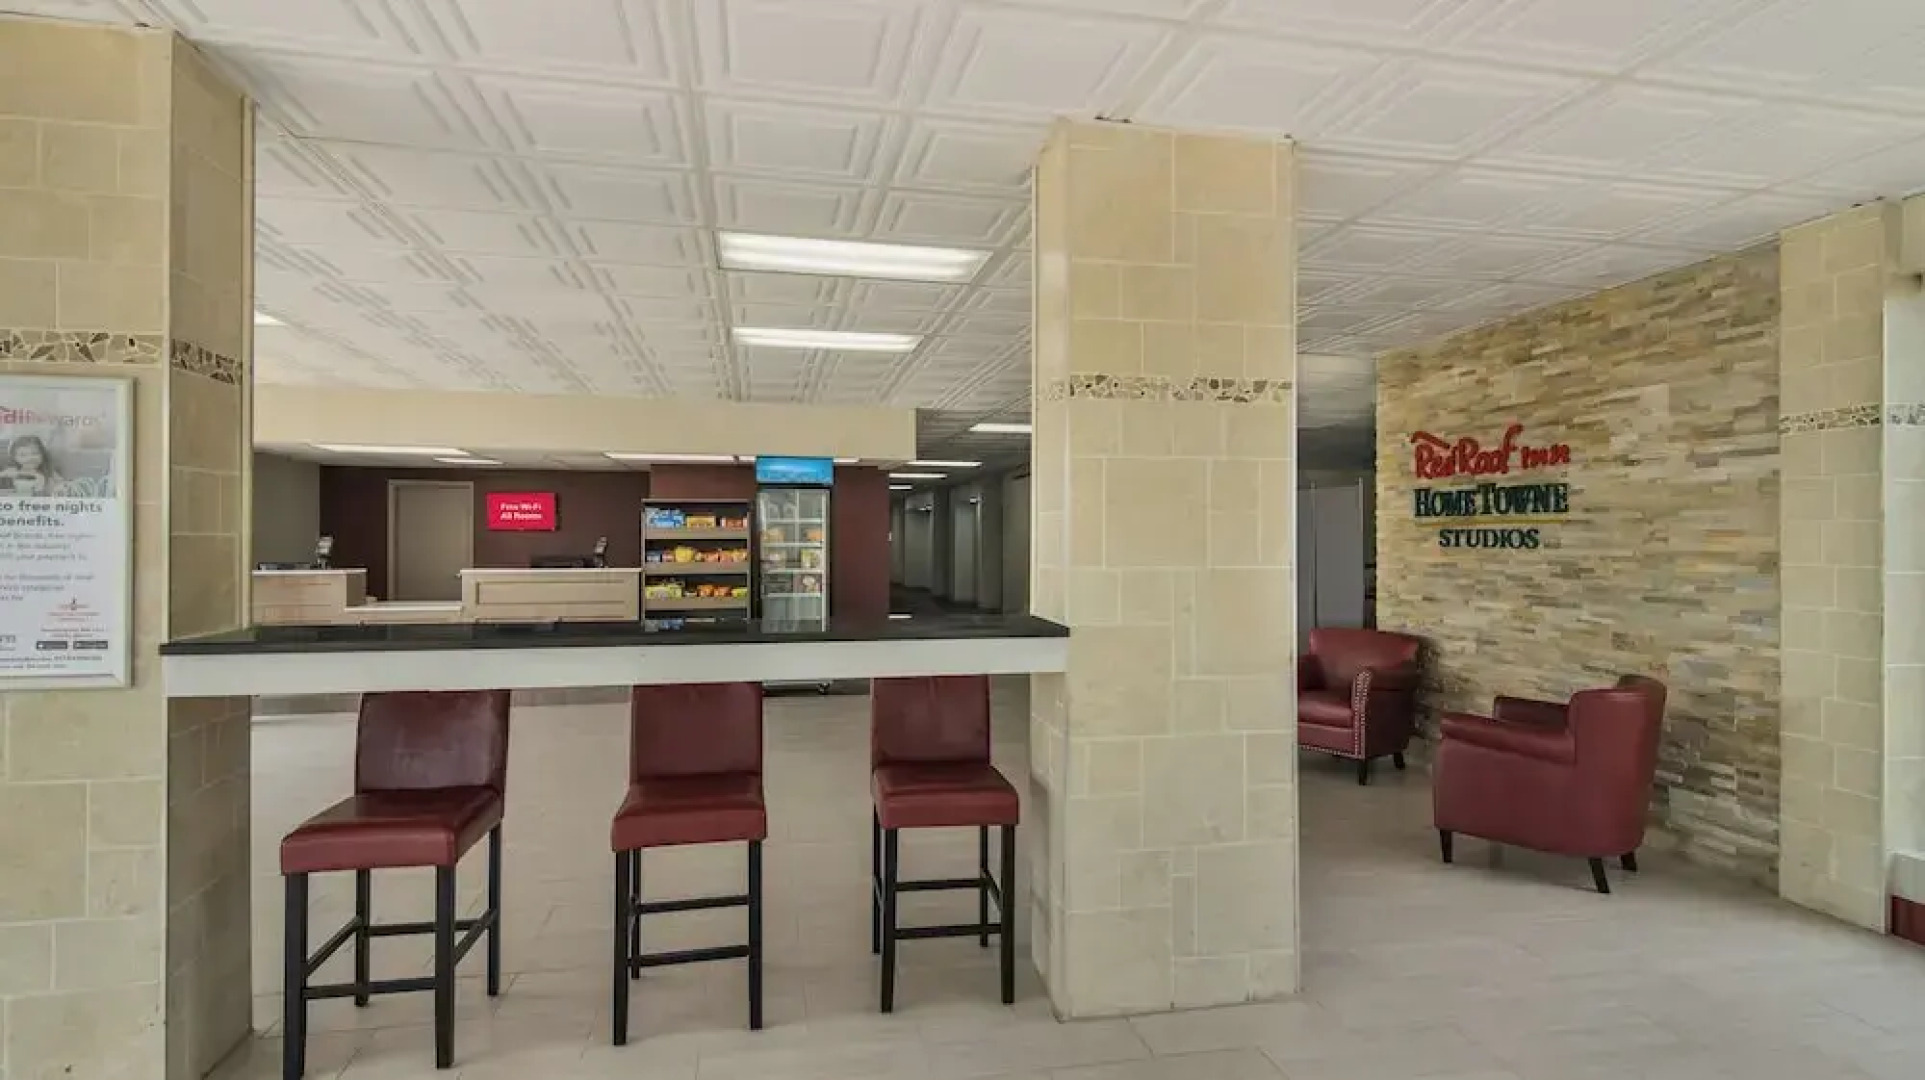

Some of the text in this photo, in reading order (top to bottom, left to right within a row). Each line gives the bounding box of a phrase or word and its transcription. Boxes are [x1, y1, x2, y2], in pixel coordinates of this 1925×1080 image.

[1415, 442, 1456, 479] Red
[1457, 424, 1524, 475] Roof
[19, 500, 51, 511] free
[56, 500, 103, 514] nights
[500, 502, 519, 511] Free
[500, 511, 543, 521] All Rooms
[1439, 529, 1540, 549] STUDIOS
